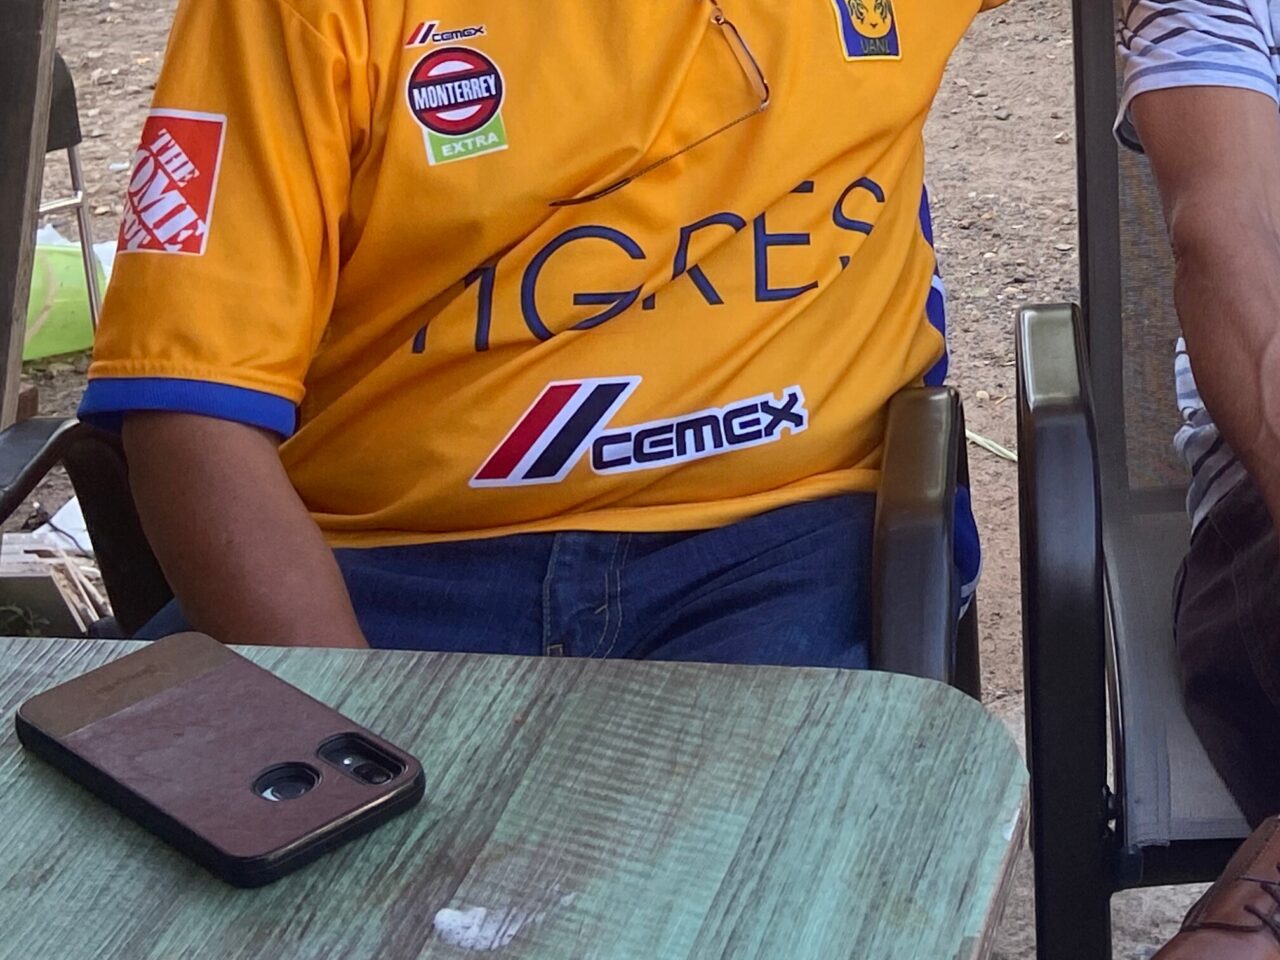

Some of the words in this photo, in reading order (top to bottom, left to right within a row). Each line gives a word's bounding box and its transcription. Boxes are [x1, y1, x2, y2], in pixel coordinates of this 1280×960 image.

[412, 74, 497, 110] MONTERREY
[149, 128, 200, 188] THE
[441, 132, 499, 156] EXTRA
[128, 149, 206, 252] OME
[592, 392, 803, 470] CEMEX
